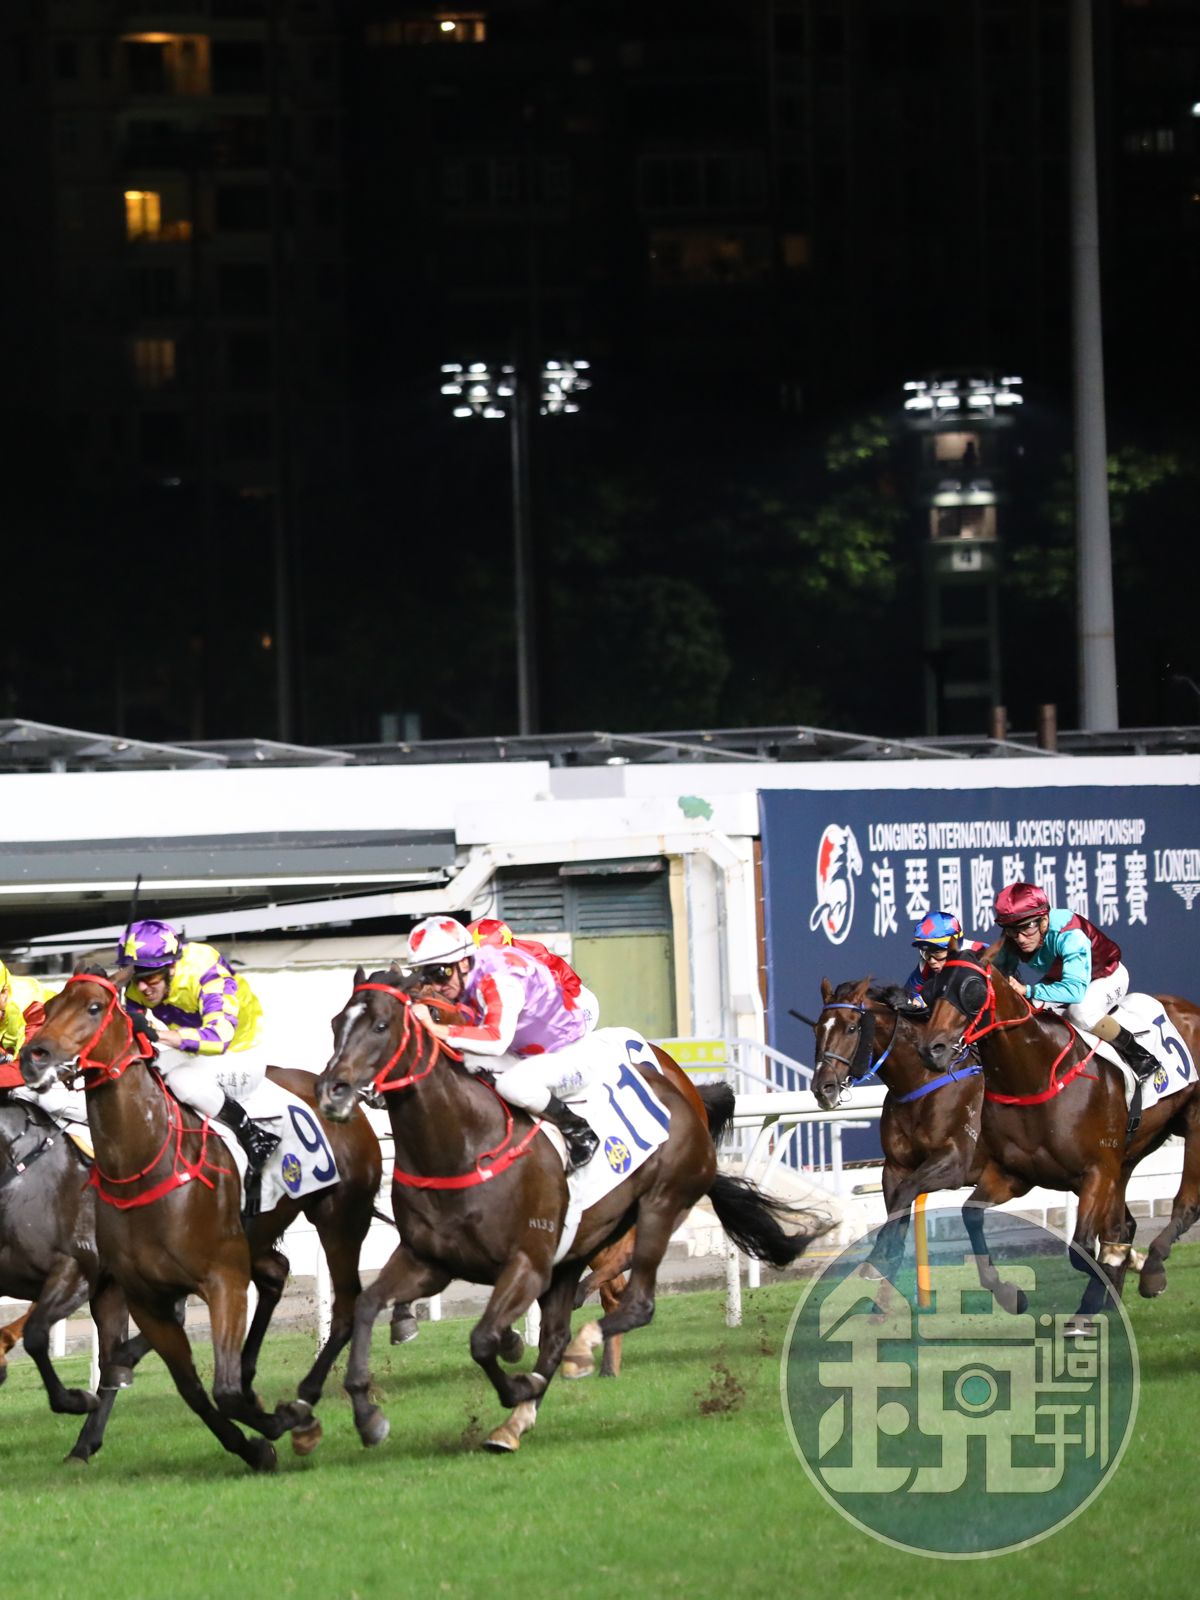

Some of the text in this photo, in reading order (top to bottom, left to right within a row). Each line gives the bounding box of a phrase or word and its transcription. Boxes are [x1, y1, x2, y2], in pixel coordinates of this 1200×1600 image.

[868, 818, 1146, 851] LONGINES INTERNATIONAL JOCKEYS' CHAMPIONSHIP
[1152, 1014, 1191, 1081] 5
[287, 1104, 336, 1182] 9
[602, 1063, 670, 1152] 11
